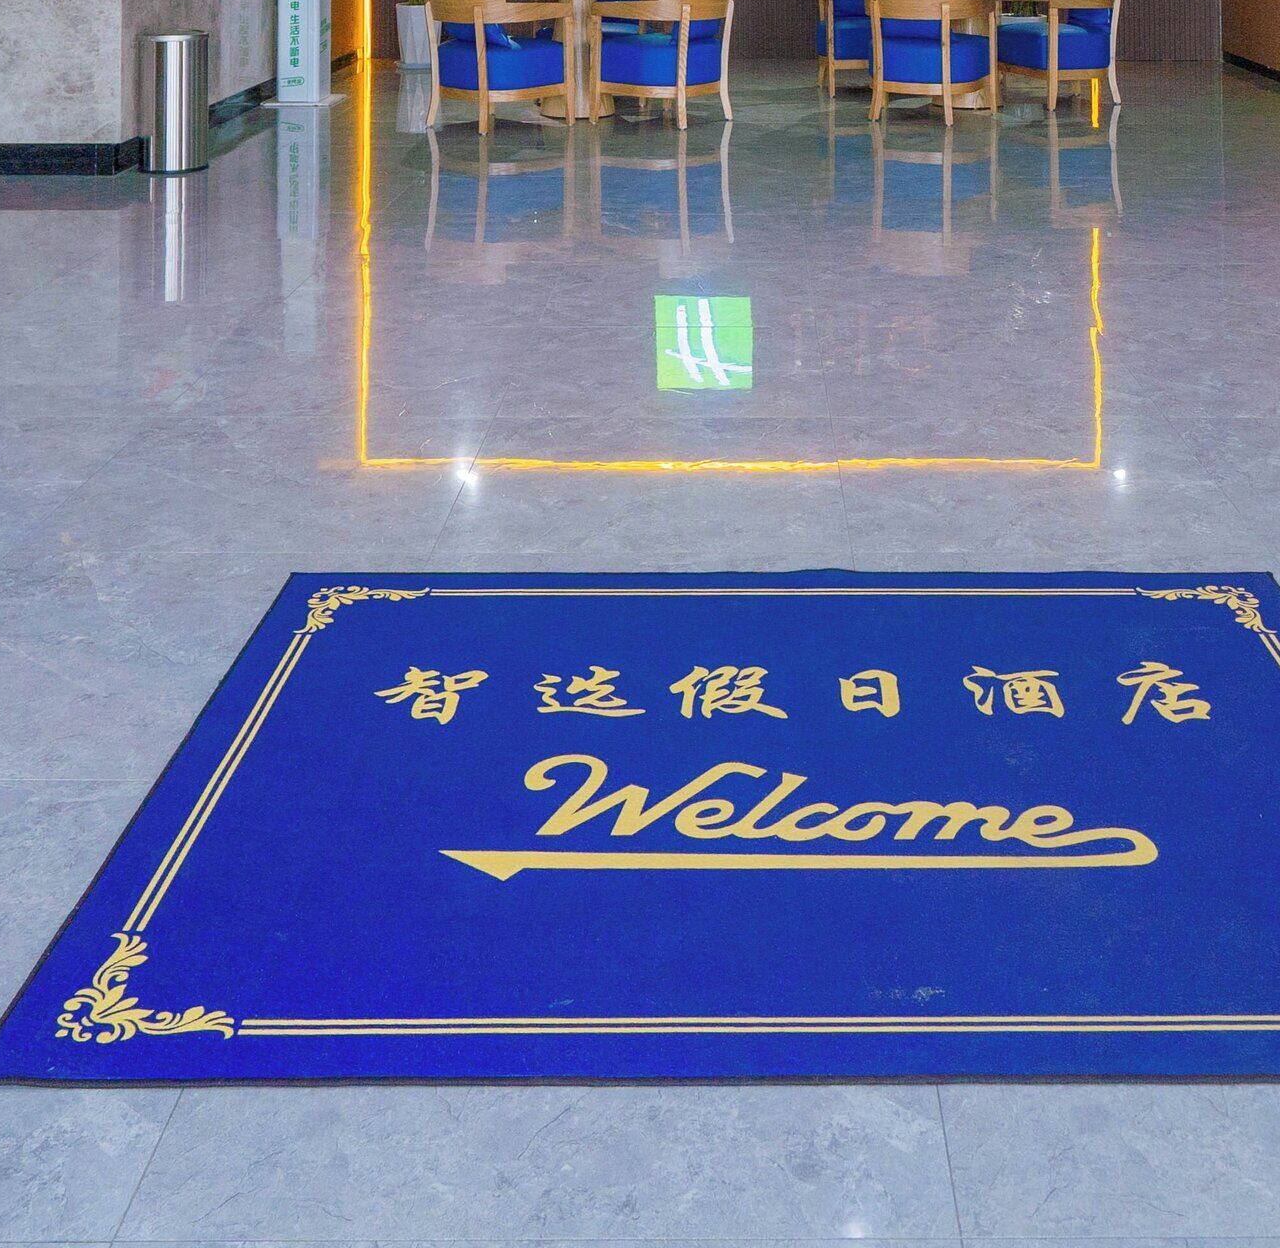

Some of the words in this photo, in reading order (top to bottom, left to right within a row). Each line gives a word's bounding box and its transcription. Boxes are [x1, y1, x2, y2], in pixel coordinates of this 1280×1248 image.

[289, 14, 300, 68] 生活不断电
[373, 661, 1214, 725] 智选假日酒店
[524, 753, 1158, 857] Welcome
